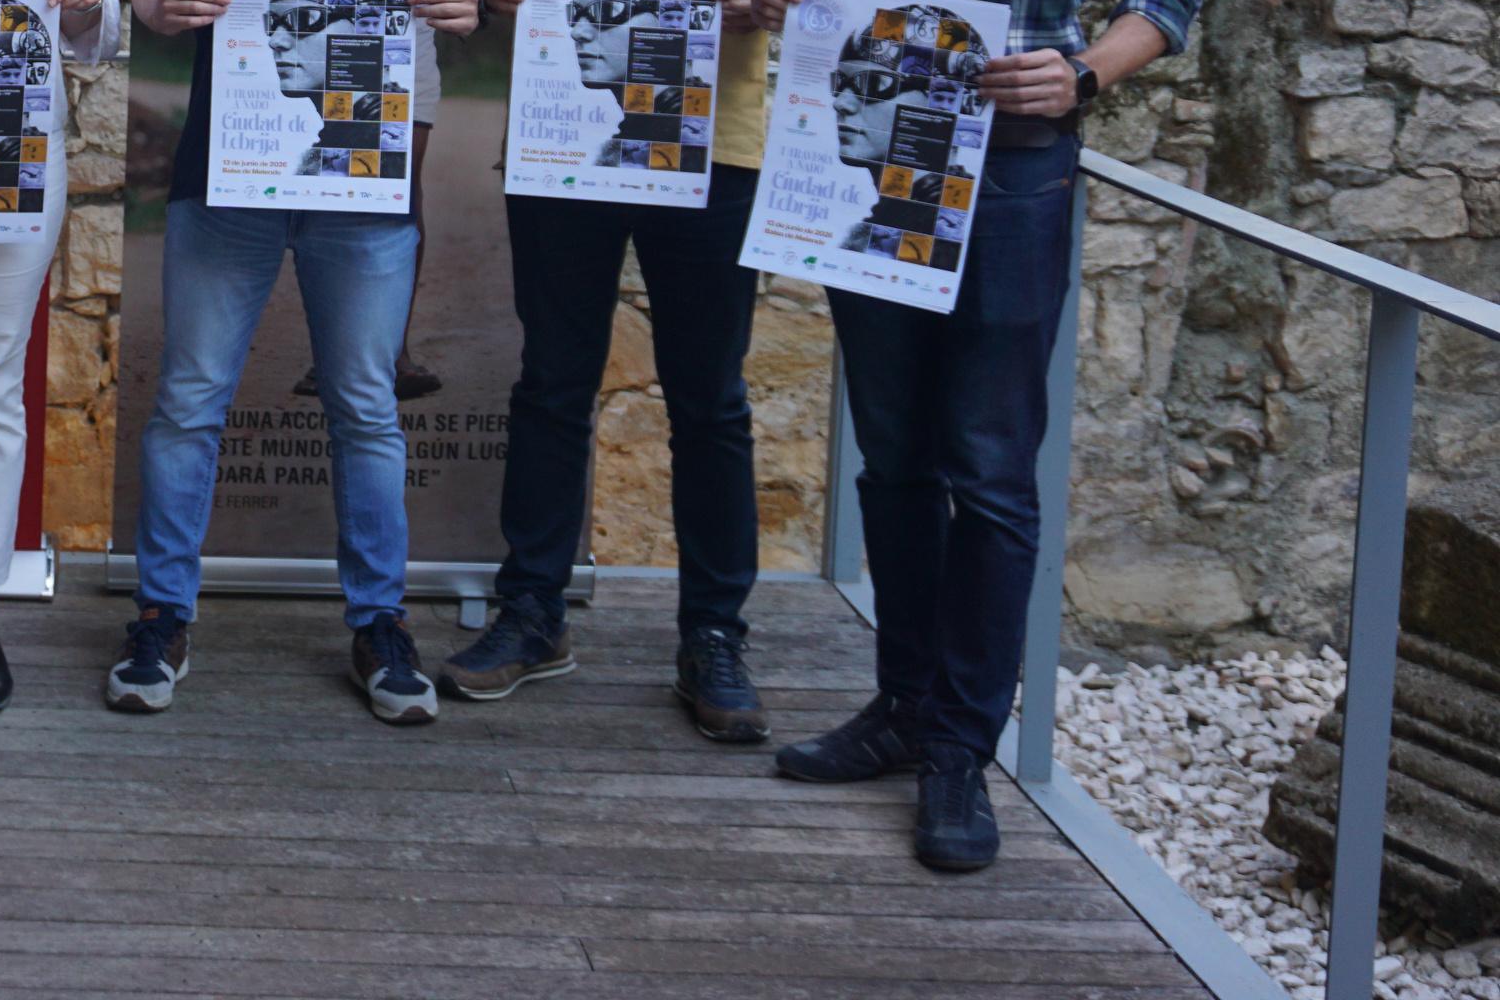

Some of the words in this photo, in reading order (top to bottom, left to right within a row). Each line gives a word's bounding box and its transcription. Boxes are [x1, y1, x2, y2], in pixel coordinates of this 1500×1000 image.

[222, 111, 283, 132] Ciudad
[288, 114, 308, 133] de
[521, 101, 582, 122] Ciudad
[589, 105, 609, 124] de
[221, 131, 280, 157] Lebrija
[520, 120, 579, 145] Lebrija
[772, 170, 836, 199] Ciudad
[841, 184, 860, 204] de
[768, 190, 829, 223] Lebrija
[225, 410, 273, 429] UNA
[434, 413, 459, 432] SE
[218, 438, 253, 457] STE
[406, 437, 459, 460] LGÚN
[468, 442, 509, 461] LUG
[275, 466, 329, 486] PARA
[227, 495, 279, 509] FERRER
